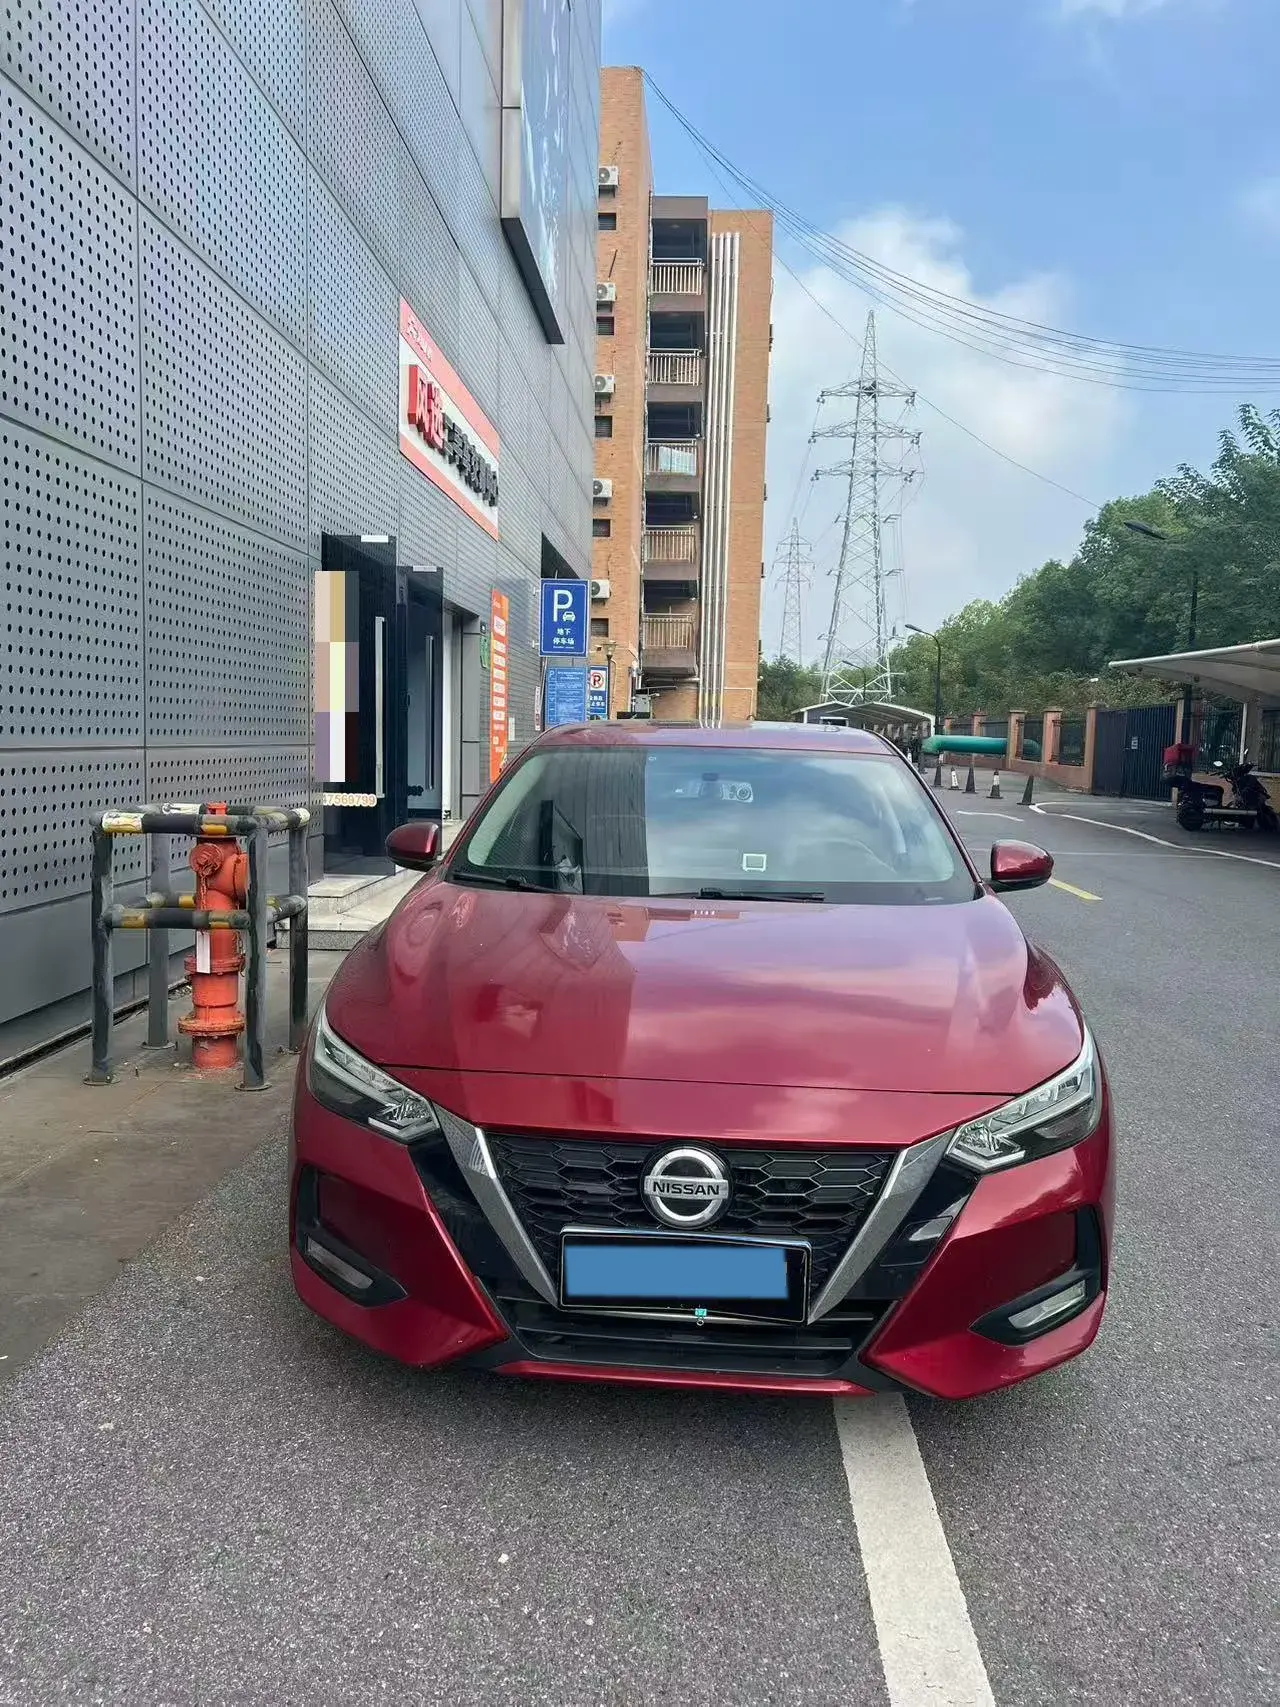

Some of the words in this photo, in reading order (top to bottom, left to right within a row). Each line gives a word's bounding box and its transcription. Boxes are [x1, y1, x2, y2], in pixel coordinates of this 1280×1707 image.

[553, 589, 573, 623] P
[557, 627, 571, 636] 地下
[552, 637, 575, 645] 停车场
[652, 1181, 721, 1196] NISSAN
